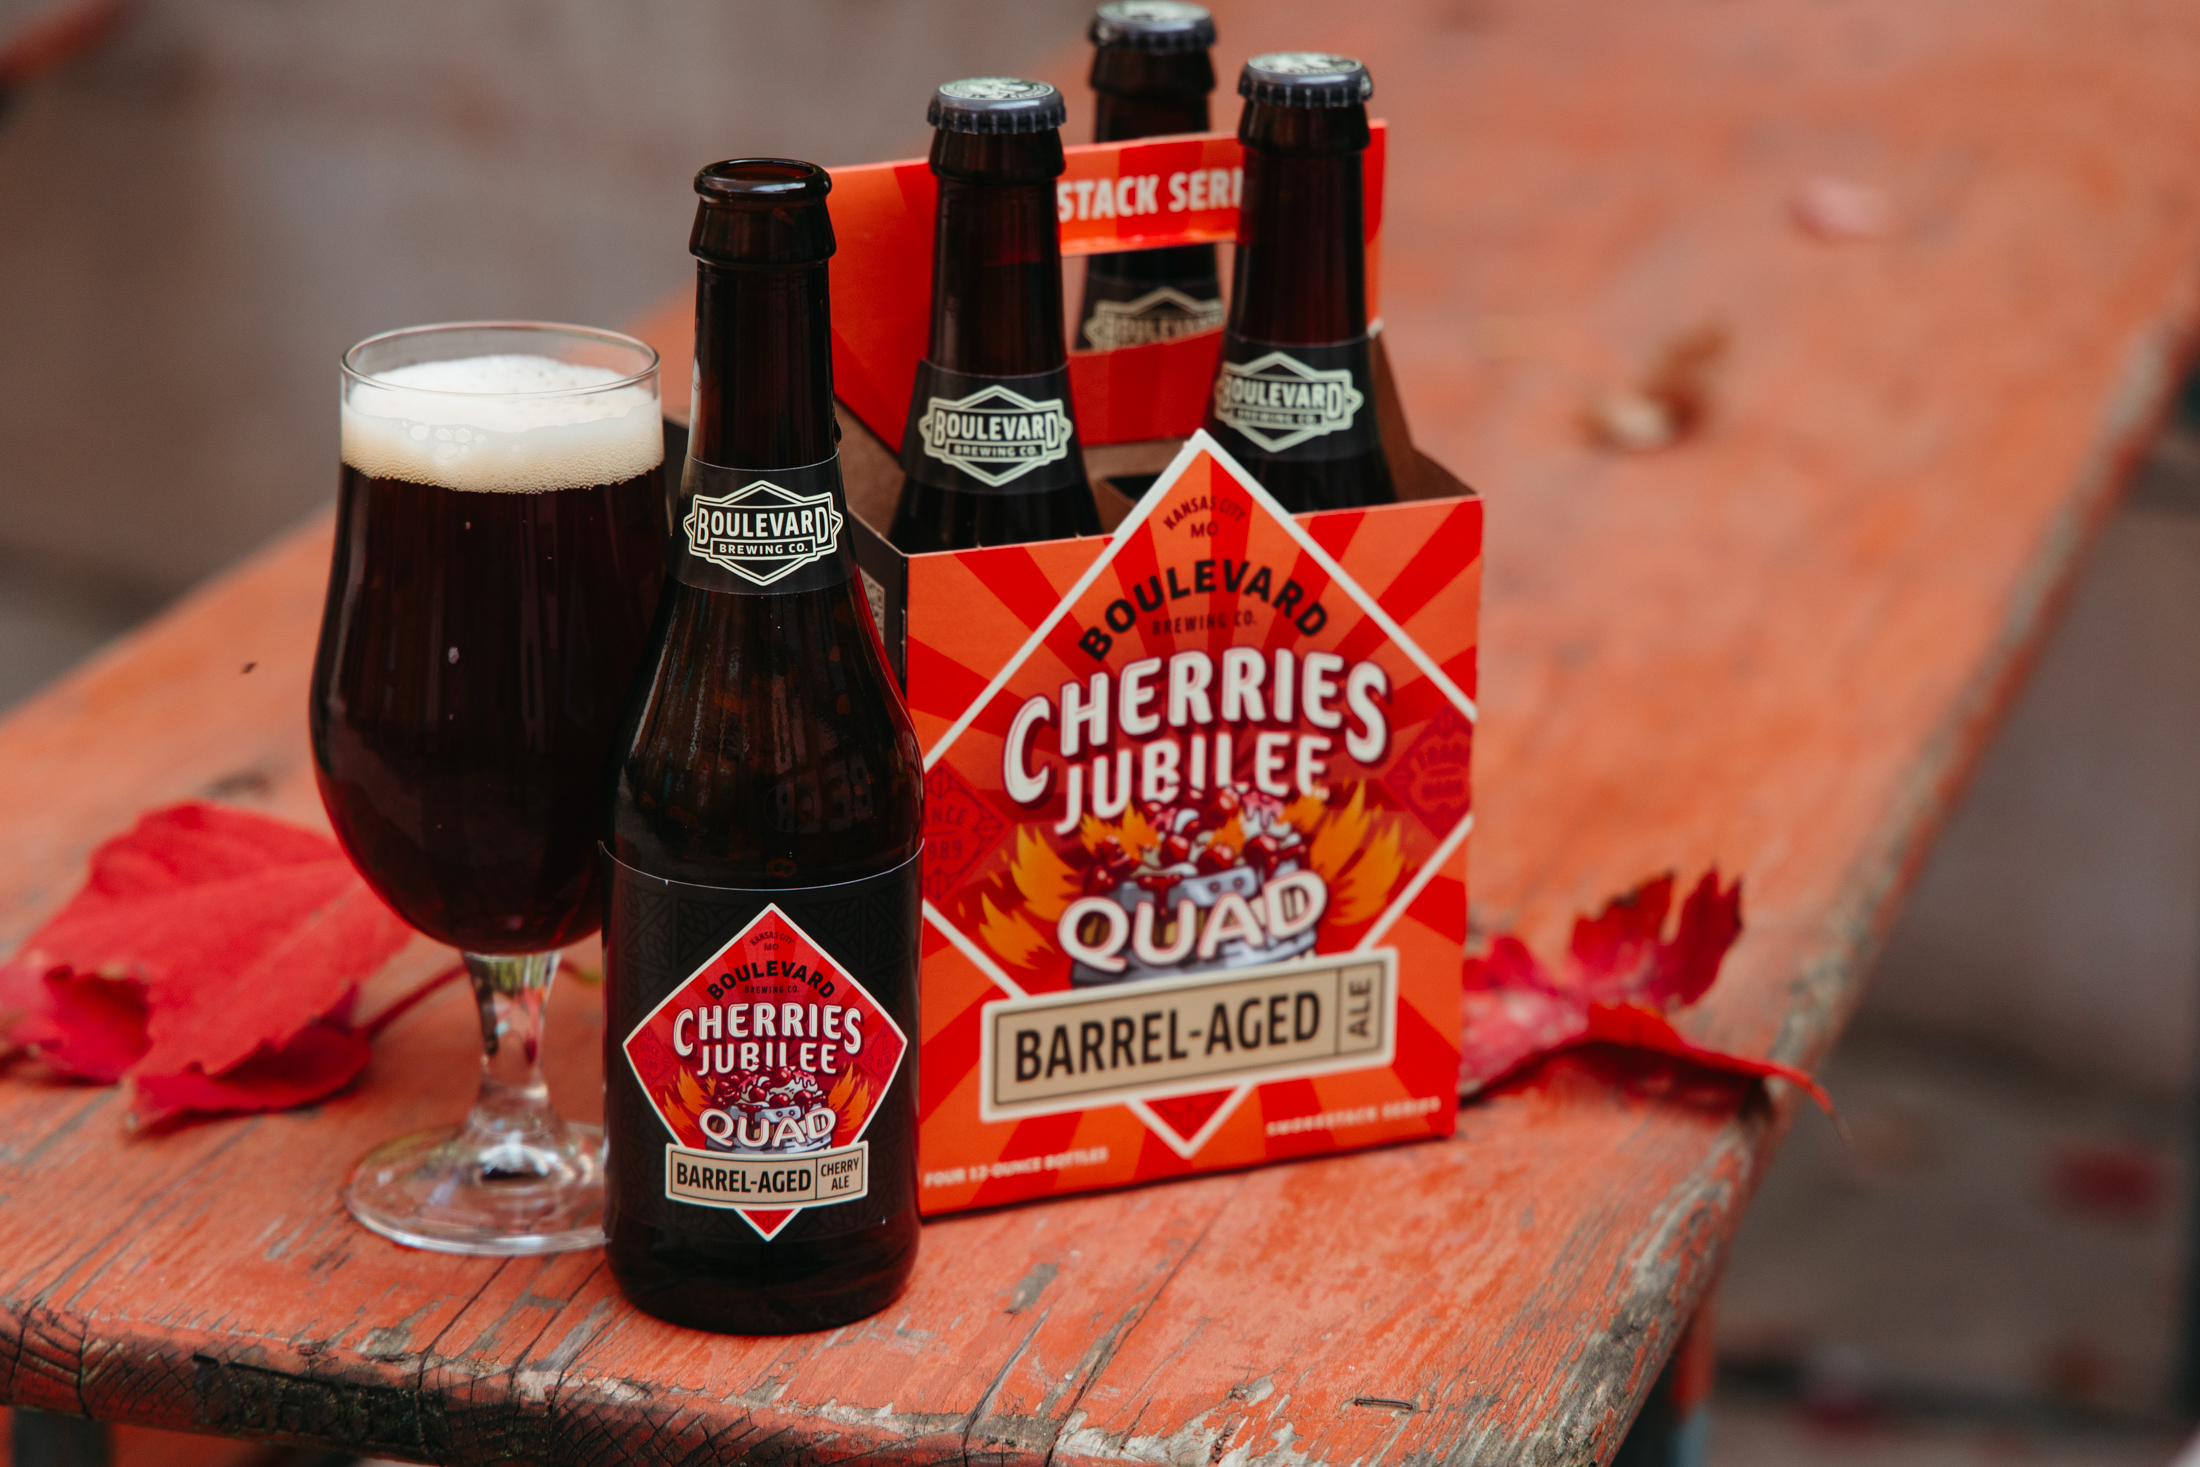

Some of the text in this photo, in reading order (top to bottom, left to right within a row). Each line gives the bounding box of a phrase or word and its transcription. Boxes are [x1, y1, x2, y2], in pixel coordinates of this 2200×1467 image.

[933, 410, 1059, 449] BOULEVARD
[954, 445, 1016, 457] BREWING
[697, 507, 829, 545] BOULEVARD
[1162, 495, 1247, 531] KANSAS CITY
[1190, 522, 1219, 538] MO
[719, 542, 808, 554] BREWING CO.
[1078, 558, 1328, 662] BOULEVARD
[1153, 609, 1258, 635] BREWING CO.
[1003, 646, 1388, 804] CHERRIES
[1055, 731, 1330, 835] JUBILEE
[749, 931, 794, 946] KANSAS CITY
[1057, 870, 1327, 972] QUAD
[764, 943, 779, 951] MO
[706, 960, 835, 1000] BOULEVARD
[744, 985, 800, 994] BREWING CO.
[1347, 978, 1371, 1039] ALE
[673, 1002, 862, 1057] CHERRIES
[1015, 989, 1321, 1083] BARREL-AGED
[697, 1042, 837, 1076] JUBILEE
[699, 1107, 837, 1147] QUAD
[676, 1162, 812, 1193] BARREL-AGED
[820, 1156, 859, 1178] CHERRY
[831, 1174, 850, 1191] ALE
[923, 1167, 966, 1188] FOUR
[1044, 1146, 1109, 1171] BOTTLES
